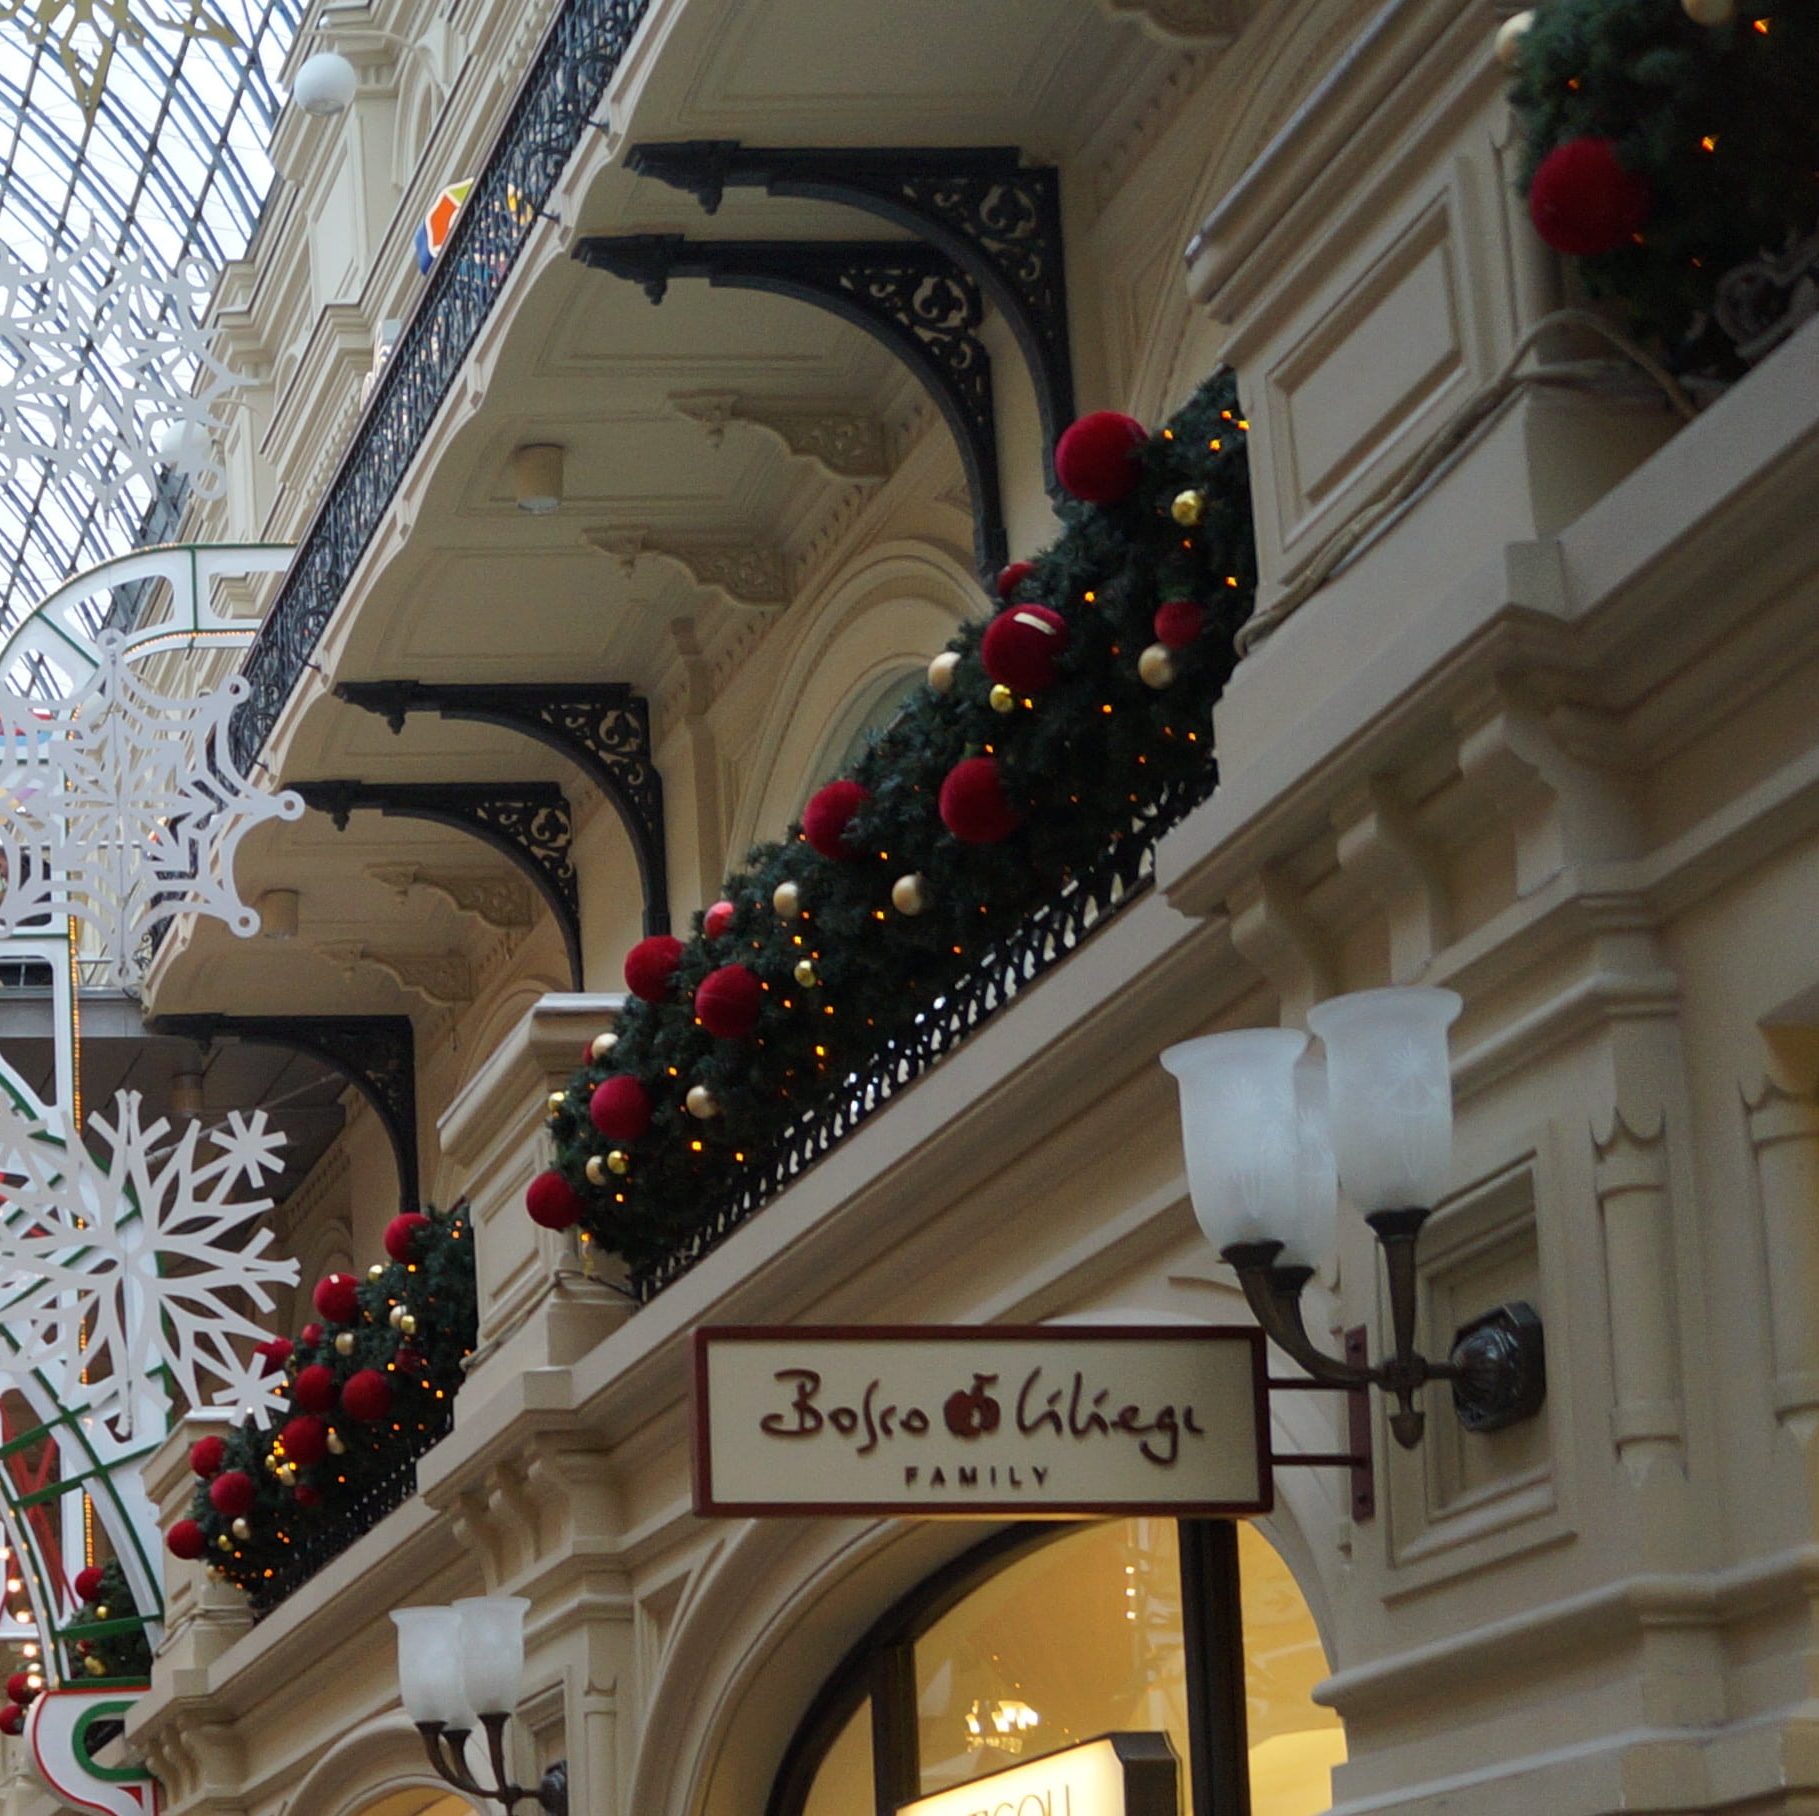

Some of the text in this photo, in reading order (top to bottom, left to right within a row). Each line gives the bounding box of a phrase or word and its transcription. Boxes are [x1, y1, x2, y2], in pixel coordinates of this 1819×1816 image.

[760, 1366, 1206, 1466] Bosco Ciliegi
[904, 1465, 1050, 1489] FAMILY
